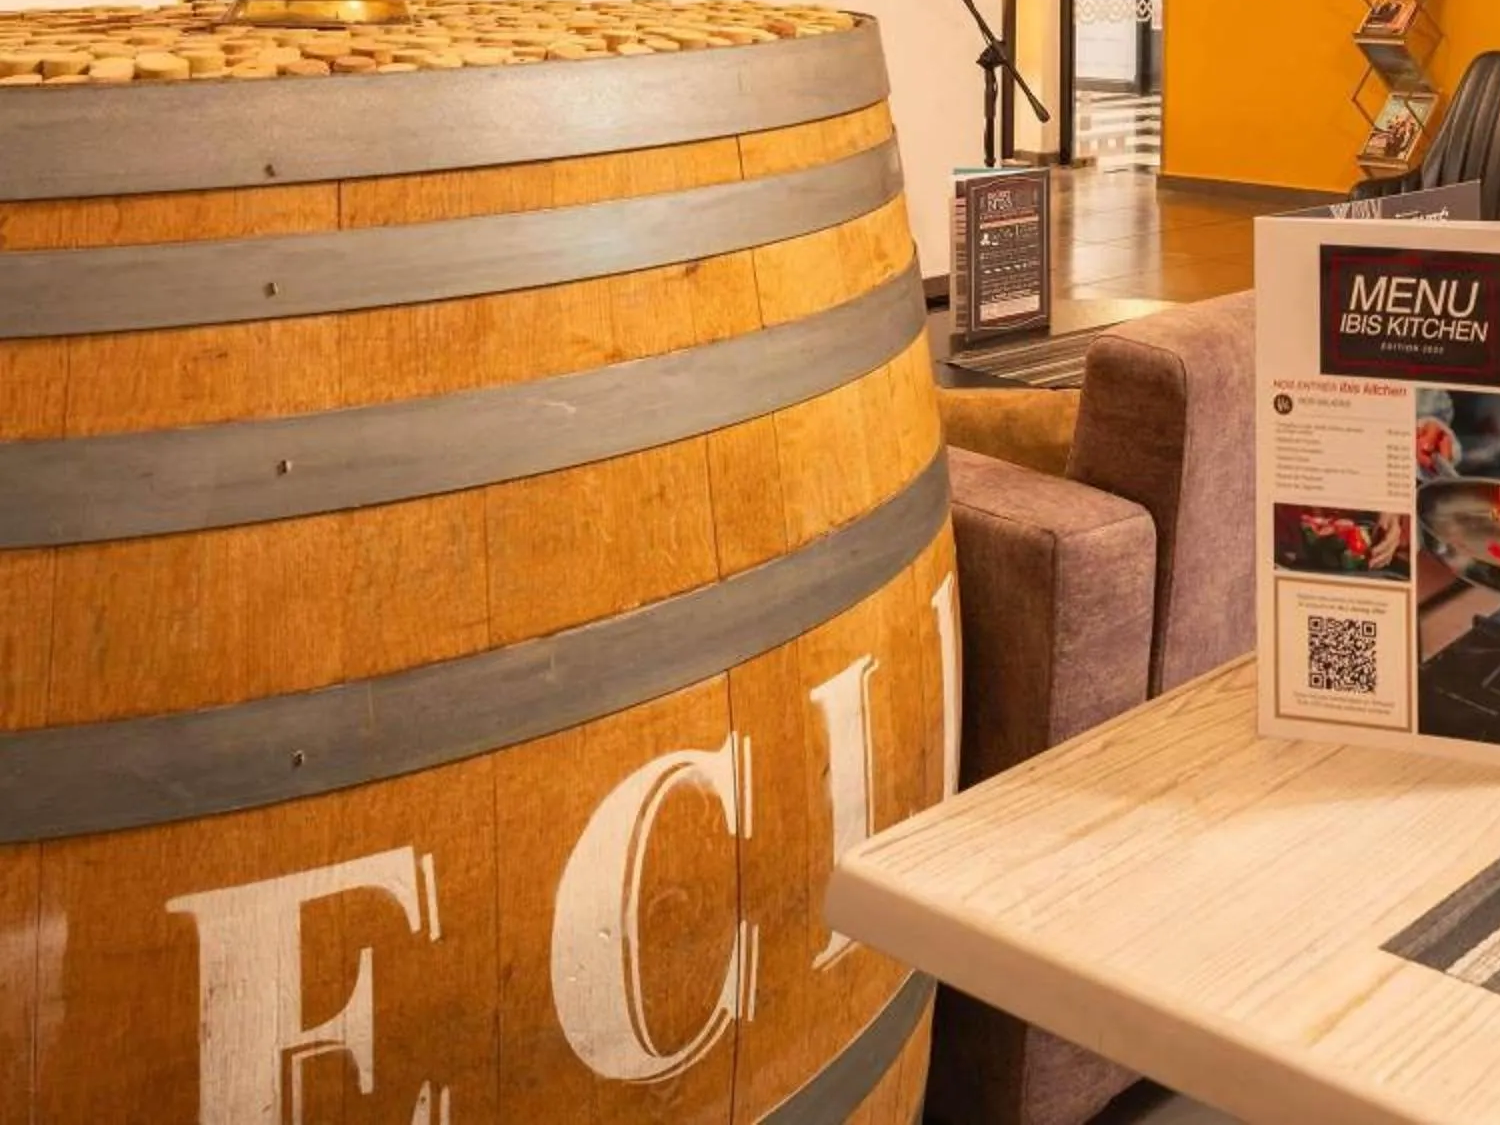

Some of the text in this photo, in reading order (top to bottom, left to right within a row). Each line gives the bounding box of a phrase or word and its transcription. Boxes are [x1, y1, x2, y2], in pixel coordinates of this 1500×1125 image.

[1349, 273, 1480, 318] MENU
[1340, 312, 1489, 343] IBIS KITCHEN
